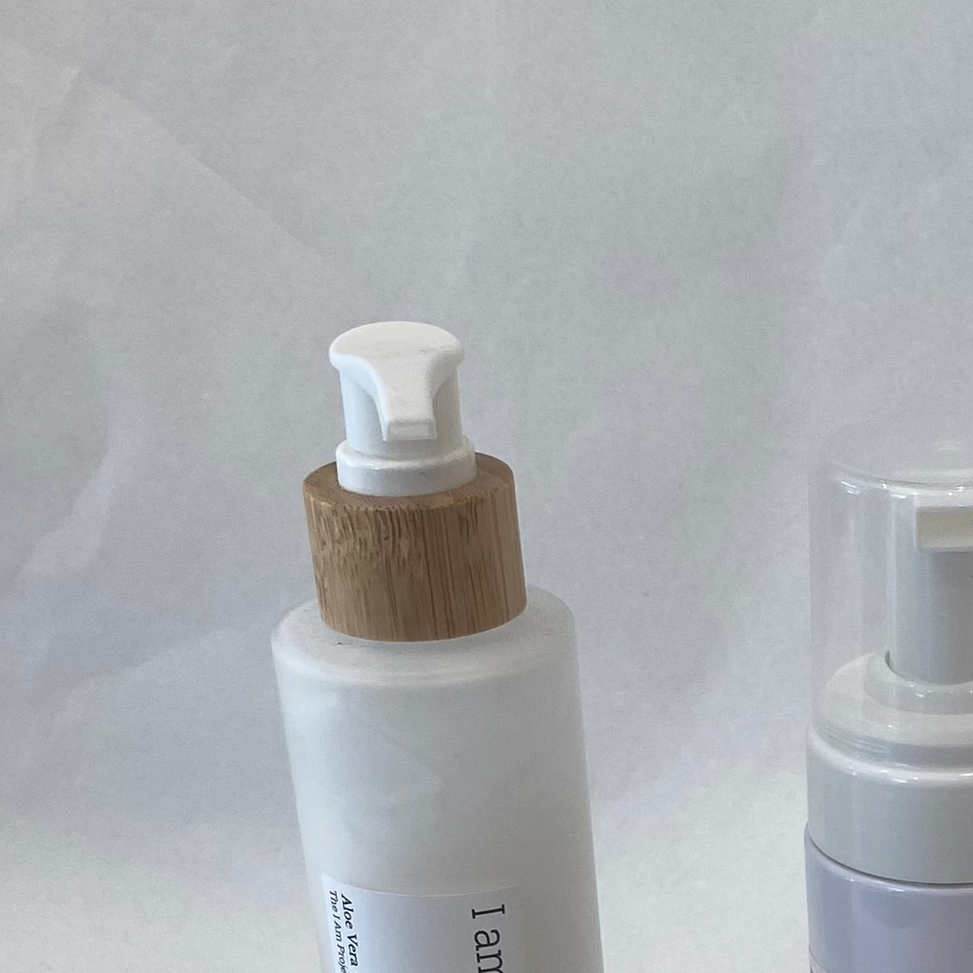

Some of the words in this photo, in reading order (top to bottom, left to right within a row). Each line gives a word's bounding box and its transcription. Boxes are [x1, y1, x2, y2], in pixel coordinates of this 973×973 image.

[329, 890, 339, 913] The
[334, 920, 343, 942] Am
[340, 893, 355, 930] Aloe
[471, 904, 505, 919] I
[346, 933, 359, 967] Vera
